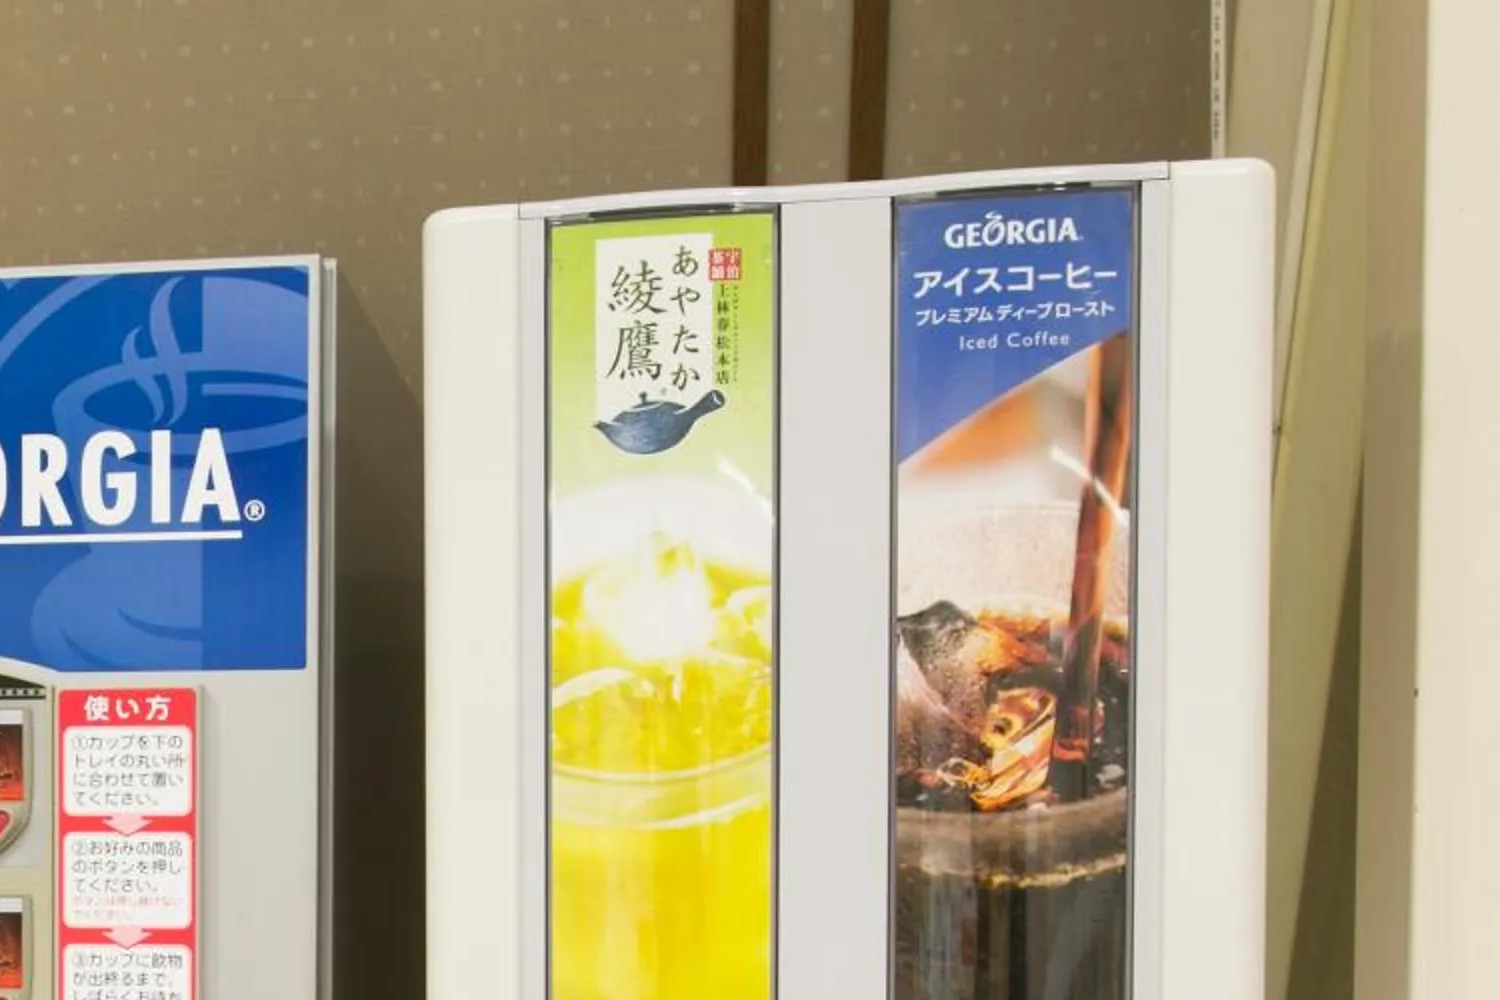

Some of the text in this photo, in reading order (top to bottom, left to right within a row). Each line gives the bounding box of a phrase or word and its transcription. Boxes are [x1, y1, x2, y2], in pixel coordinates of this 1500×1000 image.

[944, 213, 1079, 249] GEORGIA
[913, 261, 1118, 299] アイスコーヒー
[606, 259, 668, 381] 綾鷹
[671, 245, 701, 391] あやたか
[959, 331, 1071, 351] Iced Coffee
[84, 695, 172, 721] 使い方
